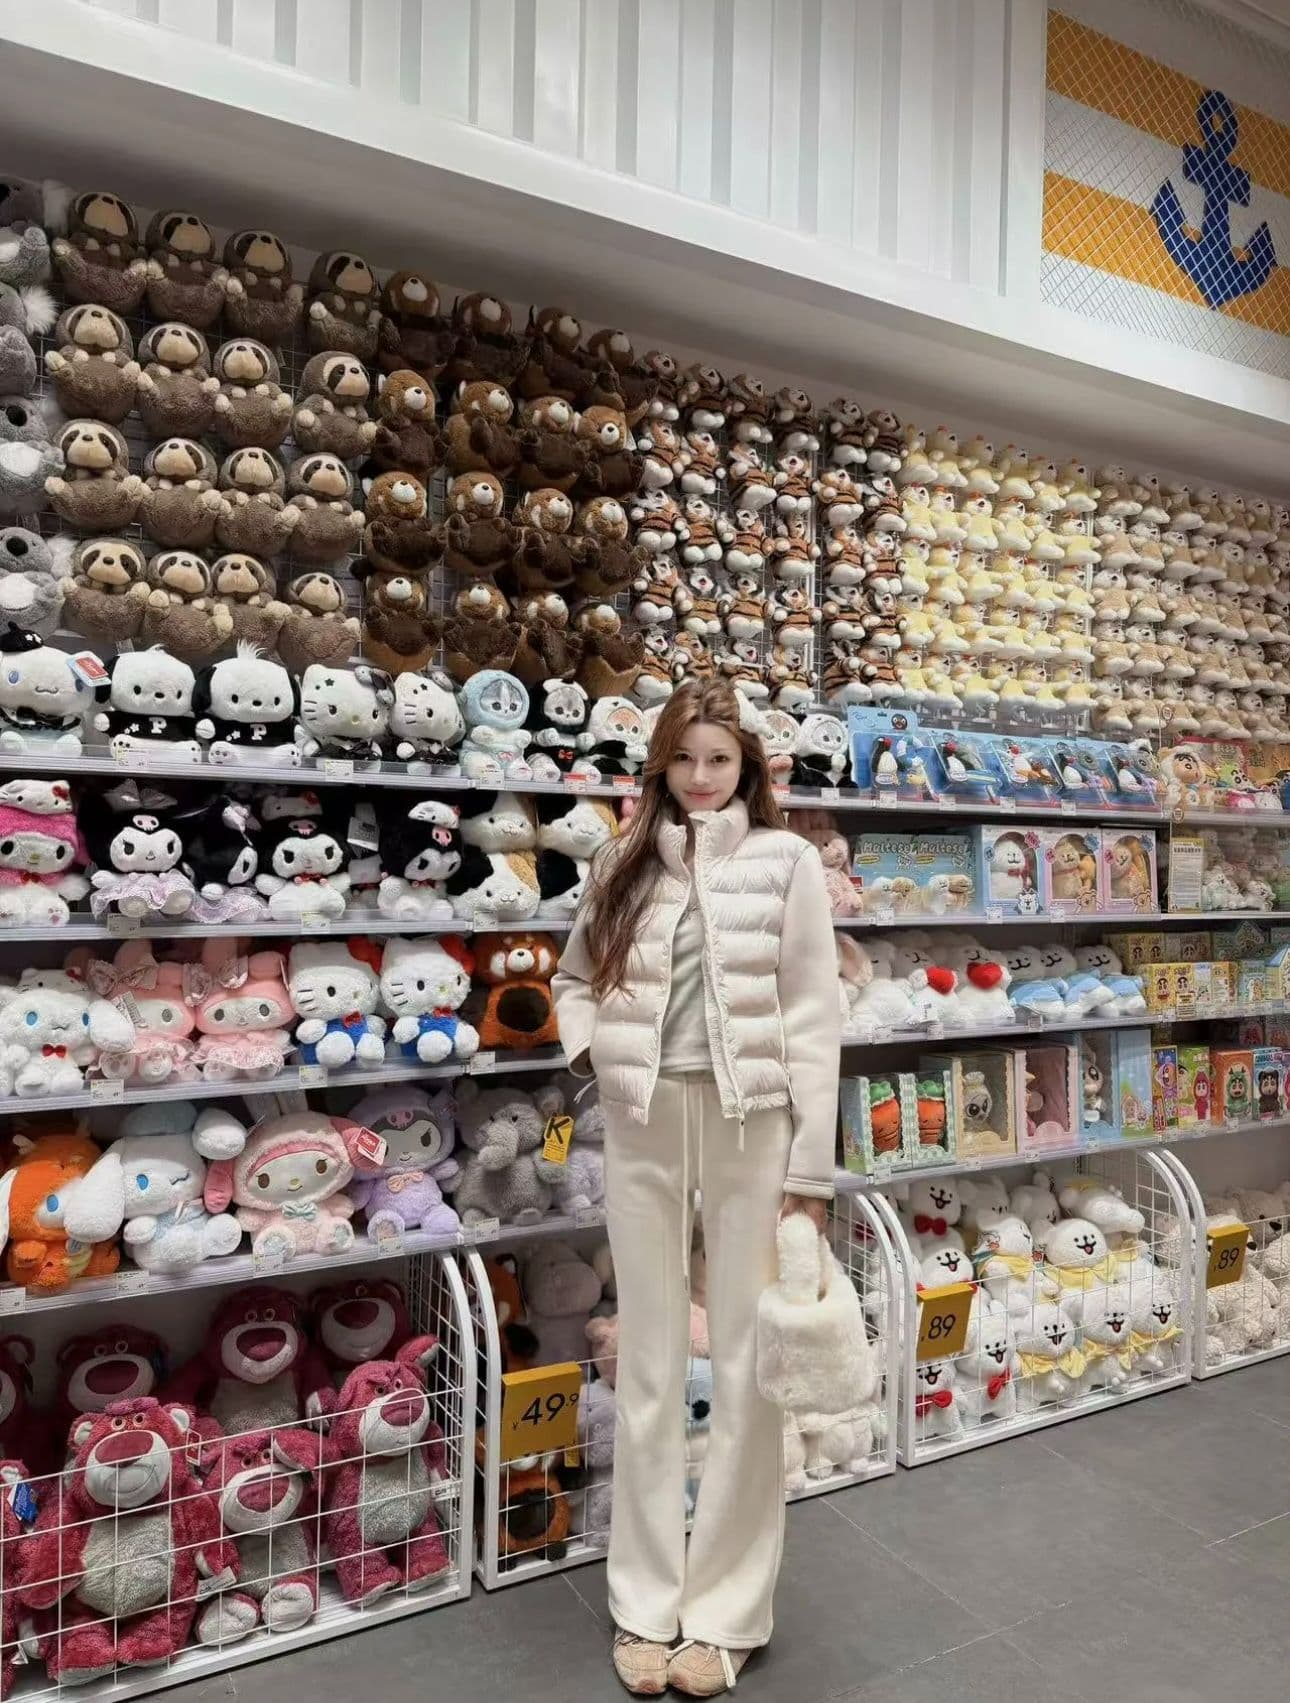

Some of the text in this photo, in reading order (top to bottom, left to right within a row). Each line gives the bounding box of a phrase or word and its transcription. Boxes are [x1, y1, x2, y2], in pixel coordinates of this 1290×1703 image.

[149, 716, 167, 734] P
[250, 723, 267, 741] P
[546, 1116, 571, 1145] K
